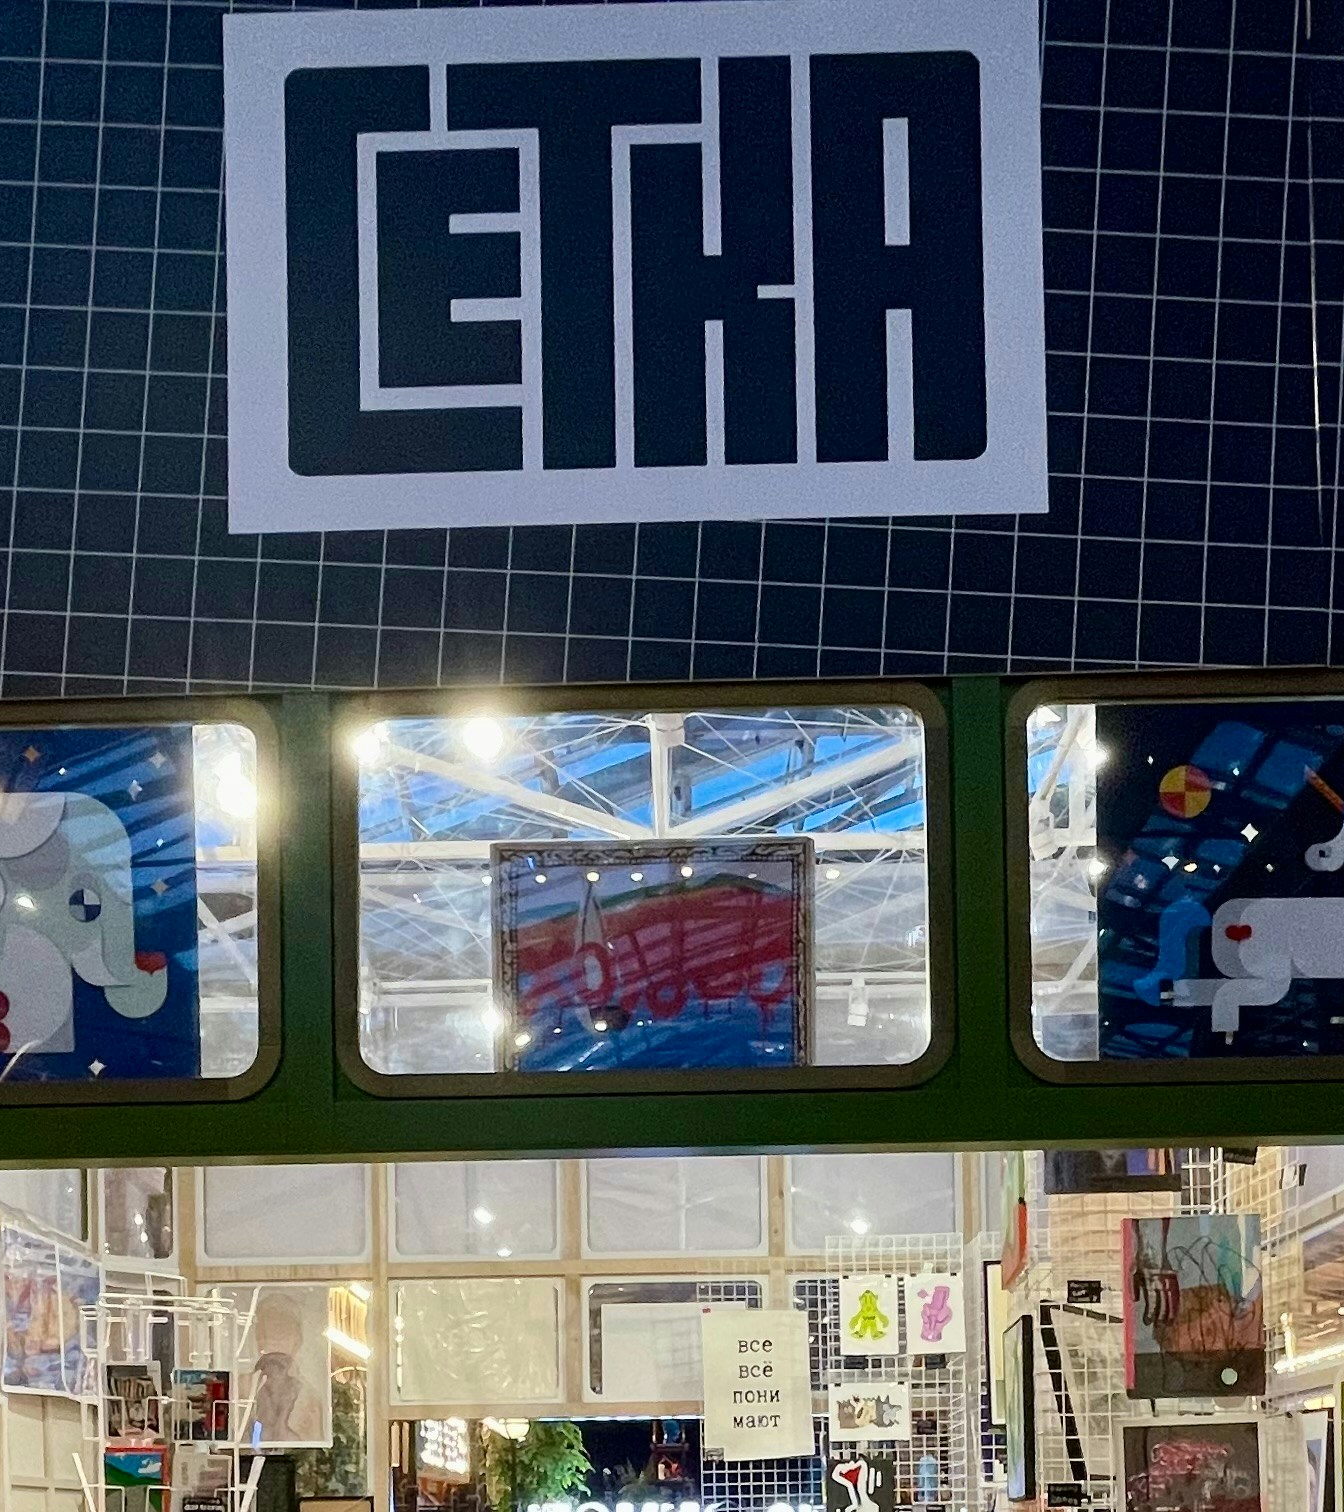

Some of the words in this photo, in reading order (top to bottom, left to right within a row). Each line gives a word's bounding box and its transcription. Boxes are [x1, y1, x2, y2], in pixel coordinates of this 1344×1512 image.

[284, 50, 988, 477] СЕТКА
[737, 1339, 773, 1354] все
[737, 1360, 774, 1379] всё
[732, 1389, 781, 1405] пони
[732, 1414, 781, 1429] мают
